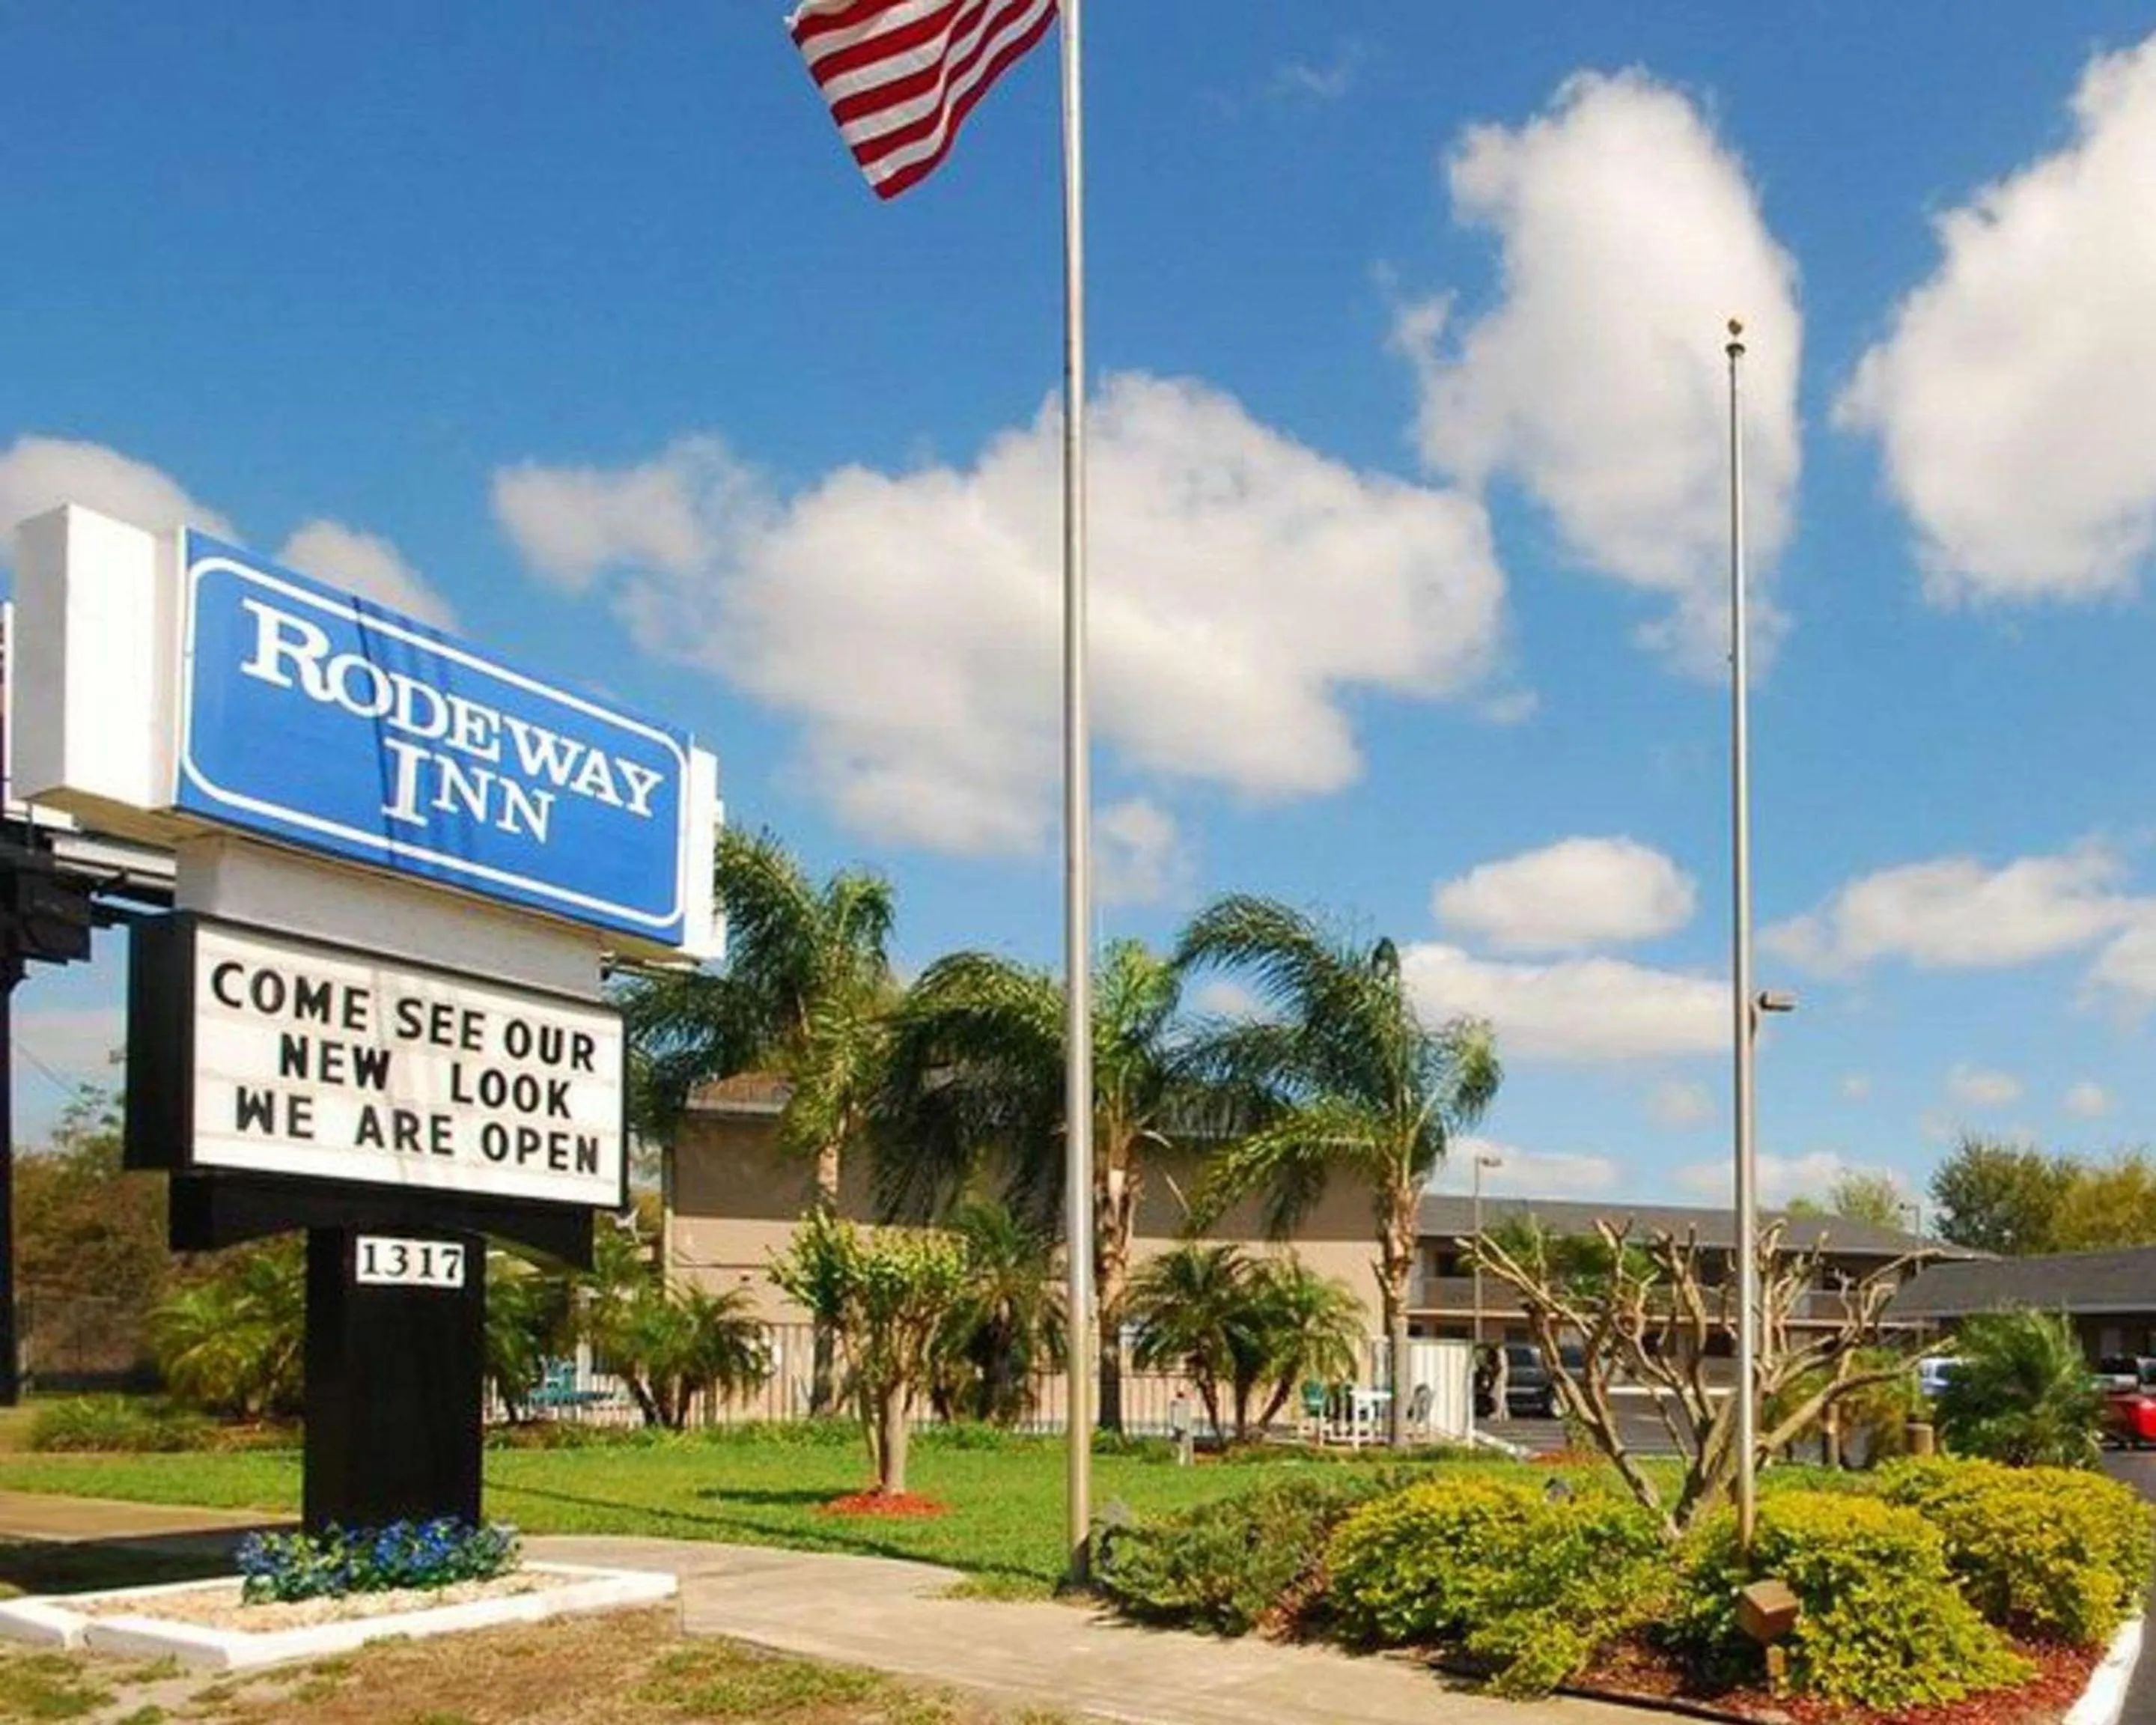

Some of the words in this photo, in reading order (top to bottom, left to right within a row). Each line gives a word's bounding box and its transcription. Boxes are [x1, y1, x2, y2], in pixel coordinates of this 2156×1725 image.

[241, 597, 664, 818] RODEWAY
[381, 737, 555, 845] INN
[212, 962, 371, 1032] COME
[395, 998, 487, 1051] SEE
[505, 1020, 596, 1073] OUR
[279, 1033, 391, 1091] NEW
[451, 1062, 572, 1120] LOOK
[236, 1086, 314, 1140] WE
[355, 1105, 454, 1156] ARE
[481, 1122, 599, 1175] OPEN
[362, 1243, 463, 1281] 1317
